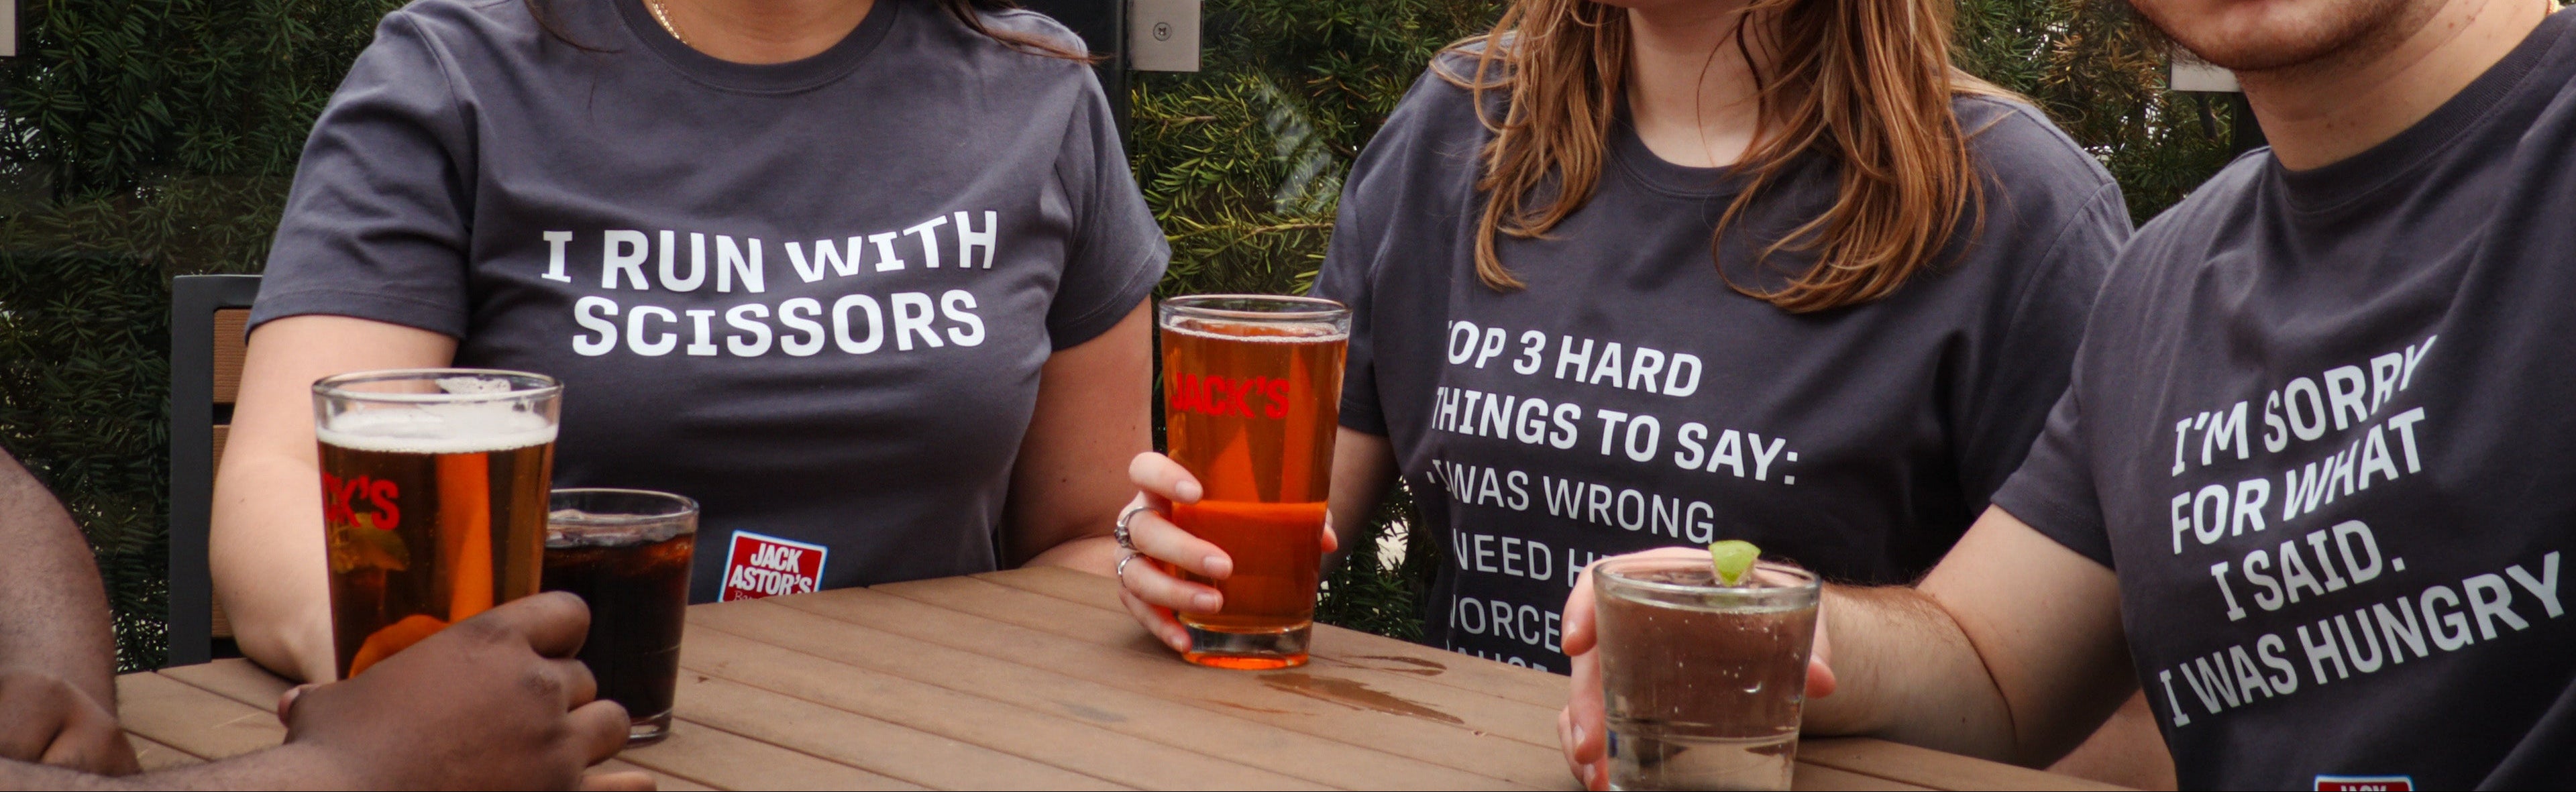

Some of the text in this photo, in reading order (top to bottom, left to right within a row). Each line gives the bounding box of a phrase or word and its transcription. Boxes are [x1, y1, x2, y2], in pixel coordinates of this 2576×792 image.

[541, 211, 998, 293] I RUN WITH
[572, 289, 985, 357] SCISSORS
[1448, 321, 1702, 396] OP 3 HARD
[1171, 372, 1289, 419] JACK'S
[2172, 335, 2437, 477] I'M SORRY
[1432, 387, 1797, 484] THINGS TO SAY:
[1446, 461, 1529, 510] WAS
[1544, 475, 1714, 544] WRONG
[2172, 407, 2424, 554] FOR WHAT
[729, 565, 812, 596] ASTOR'S
[750, 543, 803, 573] JACK
[1454, 528, 1552, 580] NEED
[2211, 520, 2405, 621] I SAID.
[1450, 594, 1561, 654] ORCE
[2160, 551, 2563, 726] I WAS HUNGRY
